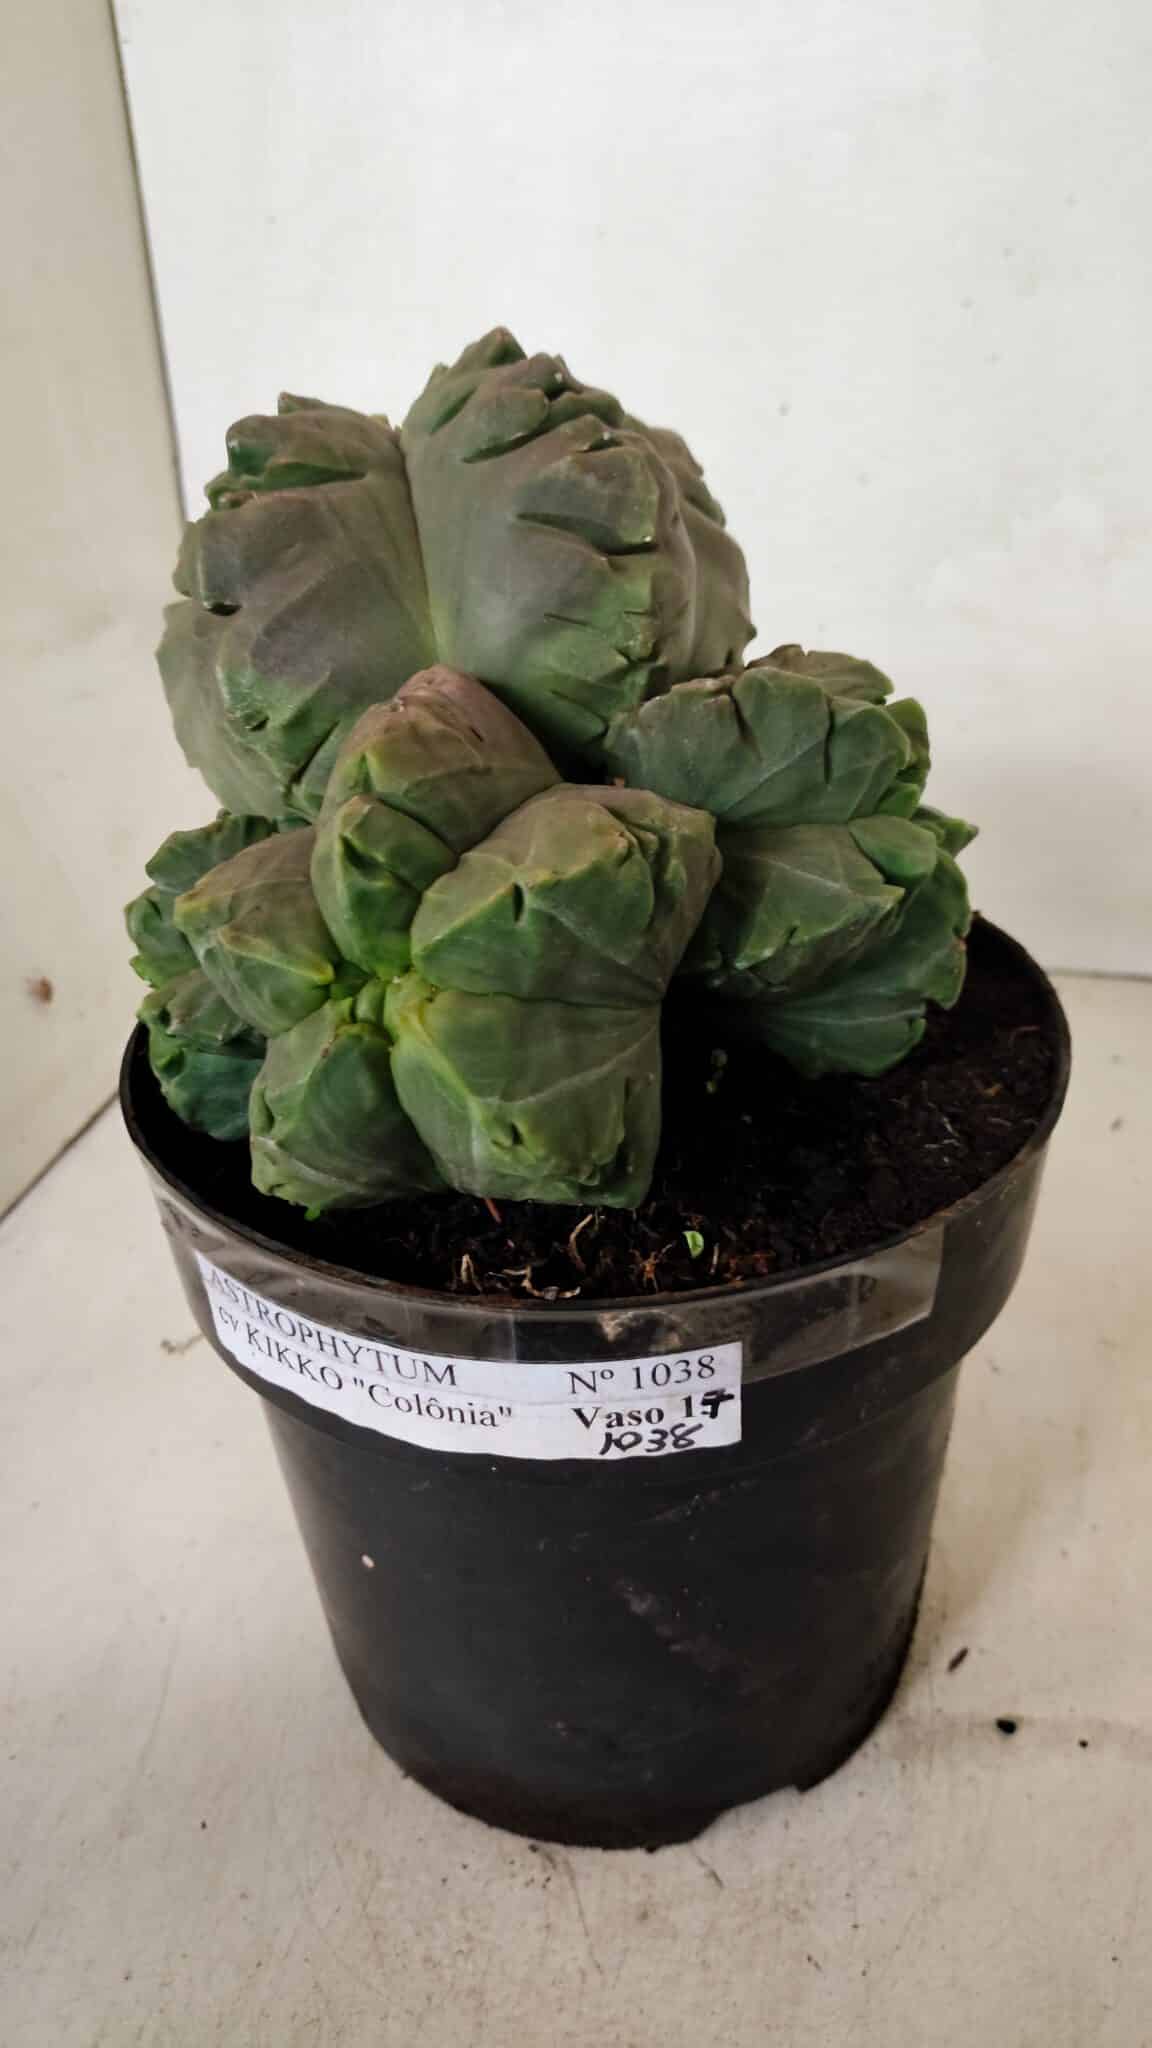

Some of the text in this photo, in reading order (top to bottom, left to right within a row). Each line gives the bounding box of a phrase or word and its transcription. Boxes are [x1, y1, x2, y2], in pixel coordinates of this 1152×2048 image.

[206, 1269, 457, 1387] ASTROPHYTUM
[246, 1321, 343, 1392] KIKKO
[352, 1376, 512, 1428] "Colônia"
[632, 1354, 716, 1390] 1038
[572, 1405, 665, 1429] Vaso
[599, 1422, 704, 1456] 1038
